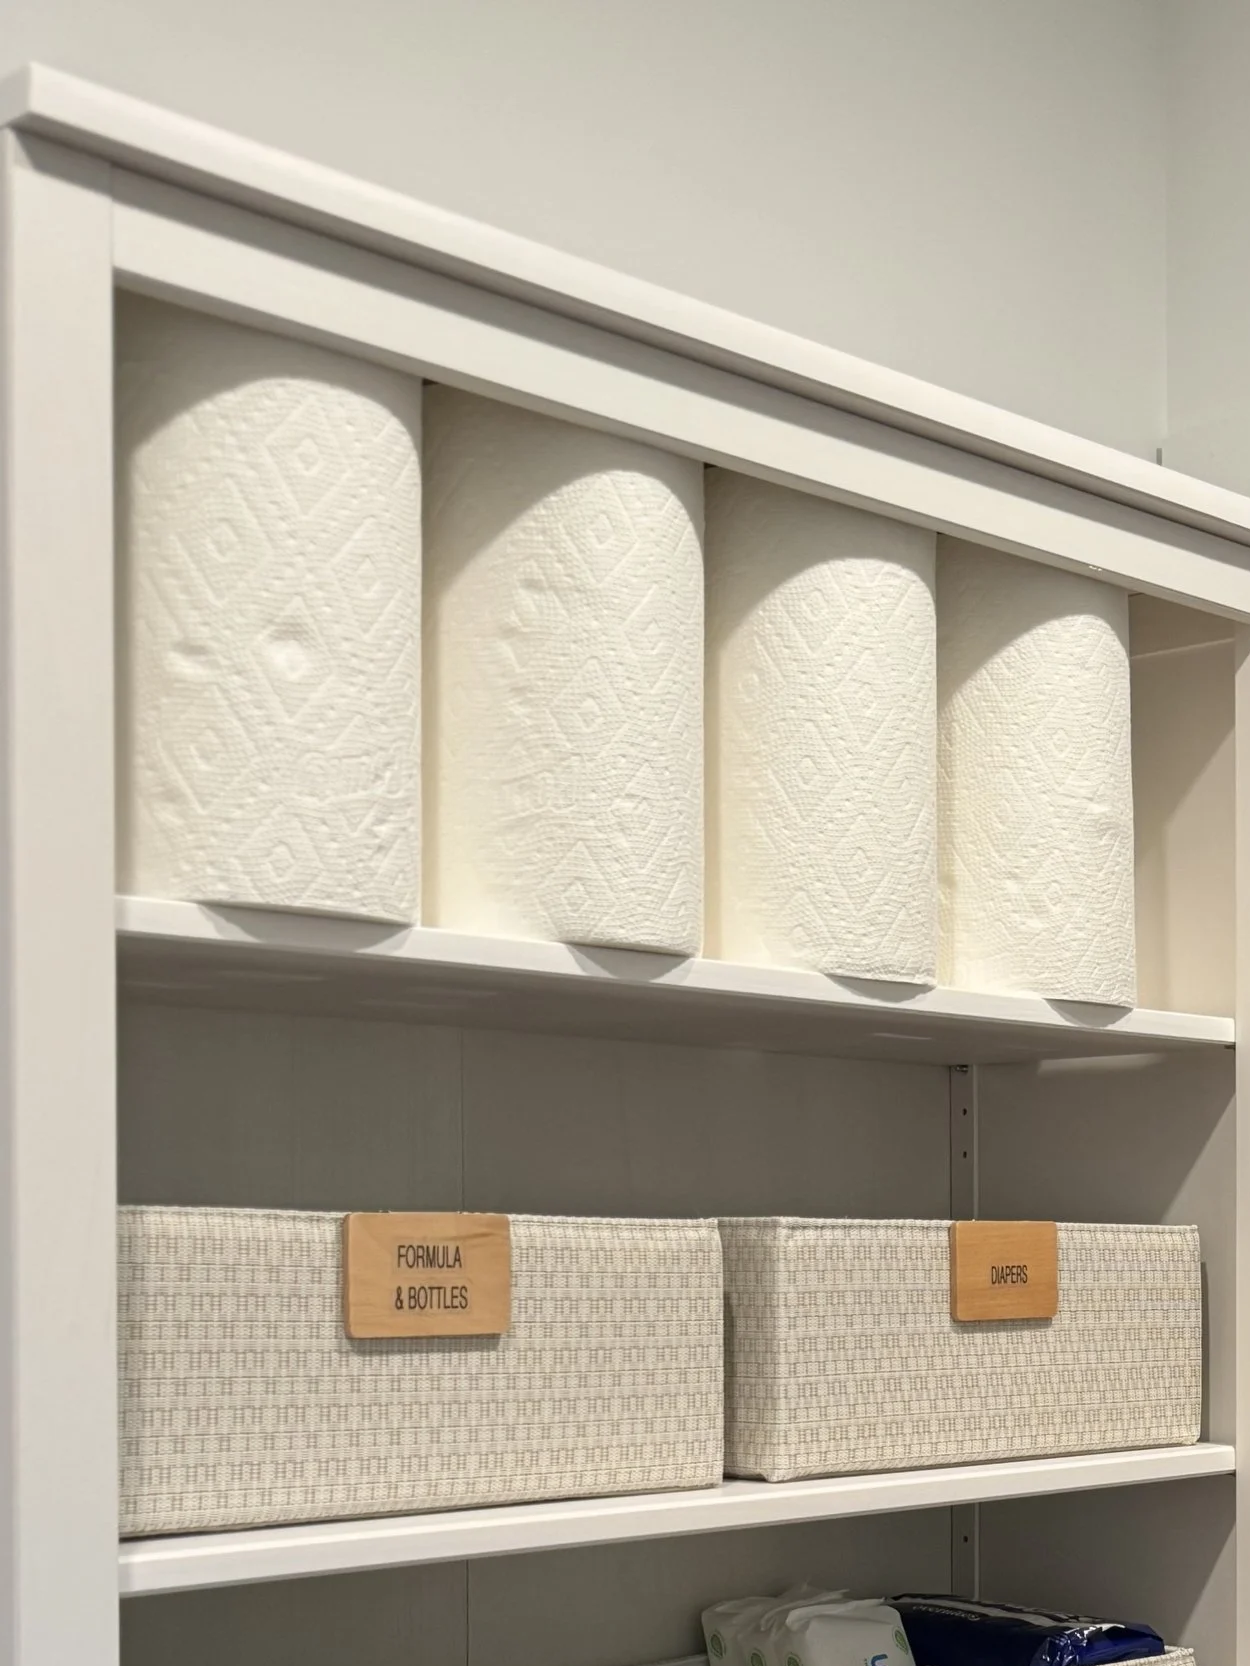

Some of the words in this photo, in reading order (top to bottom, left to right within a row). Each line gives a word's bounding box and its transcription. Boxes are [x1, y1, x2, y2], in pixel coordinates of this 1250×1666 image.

[397, 1244, 463, 1270] FORMULA
[990, 1264, 1029, 1286] DIAPERS
[395, 1285, 404, 1310] &
[407, 1285, 469, 1310] BOTTLES
